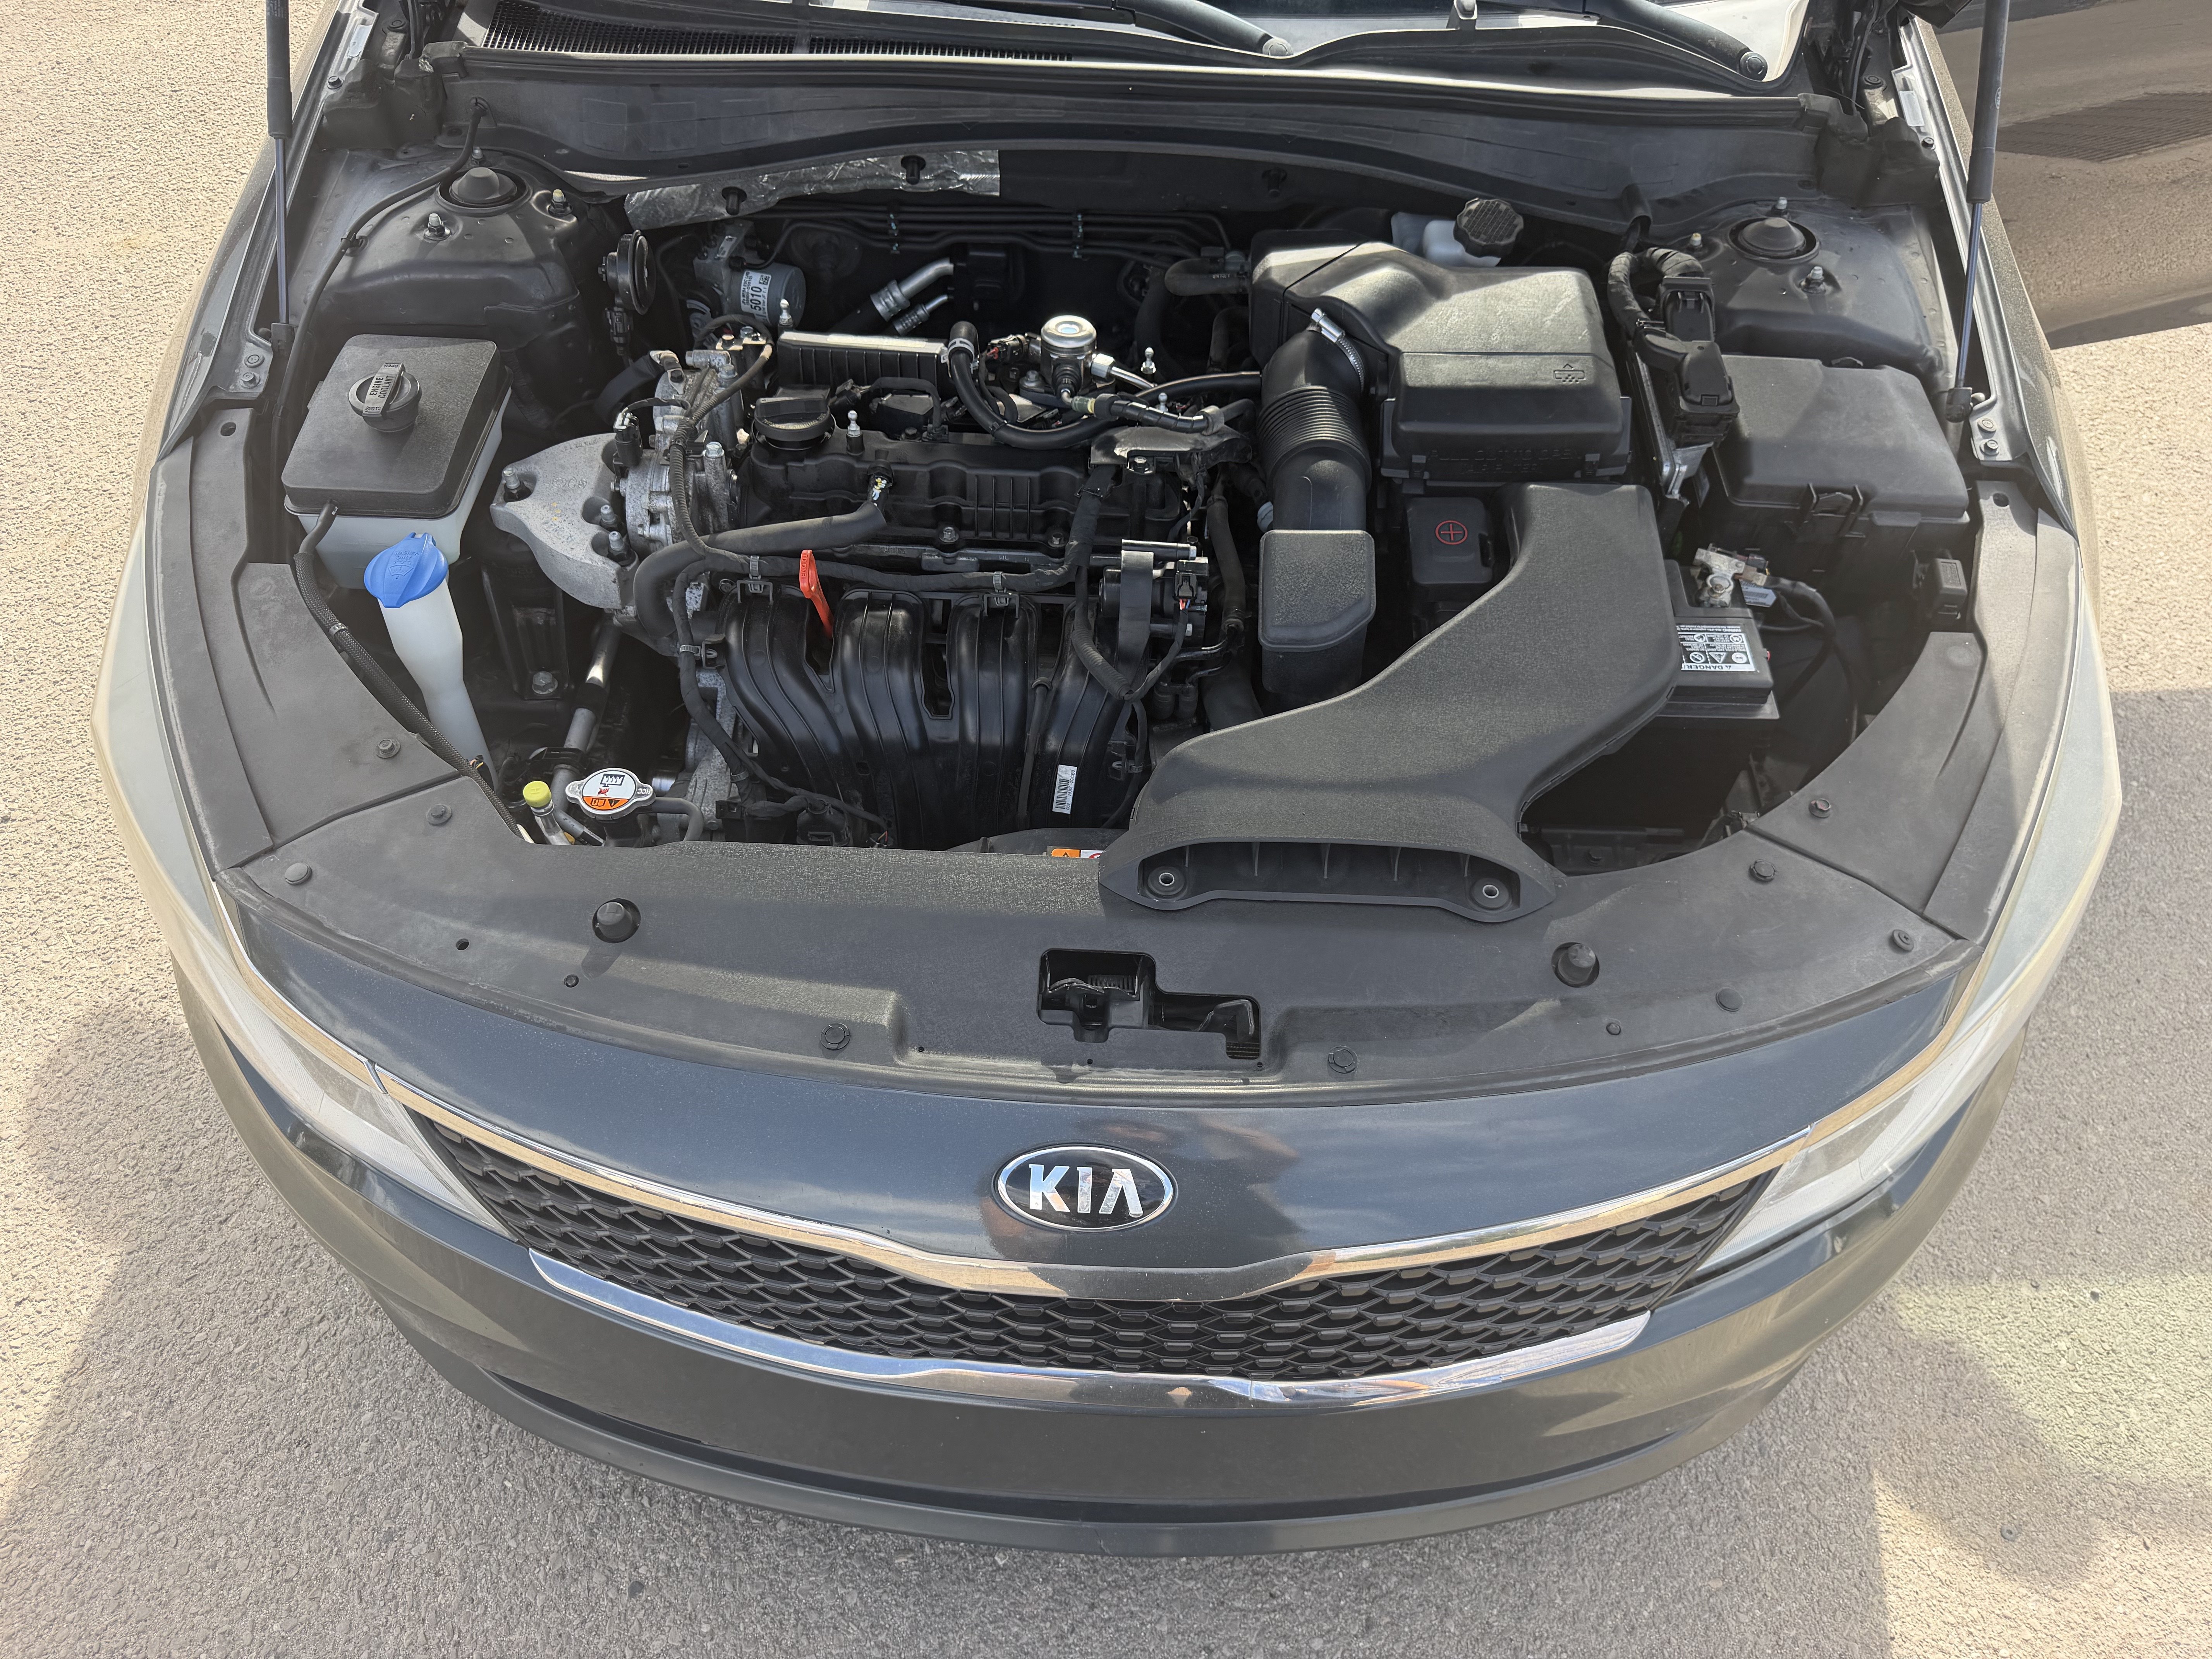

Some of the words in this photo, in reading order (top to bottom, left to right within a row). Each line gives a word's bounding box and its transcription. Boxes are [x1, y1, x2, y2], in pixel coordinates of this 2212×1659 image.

[750, 286, 762, 311] 5010
[369, 377, 384, 395] ENGINE
[378, 375, 394, 398] COOLANT
[1029, 1163, 1144, 1218] KIA
